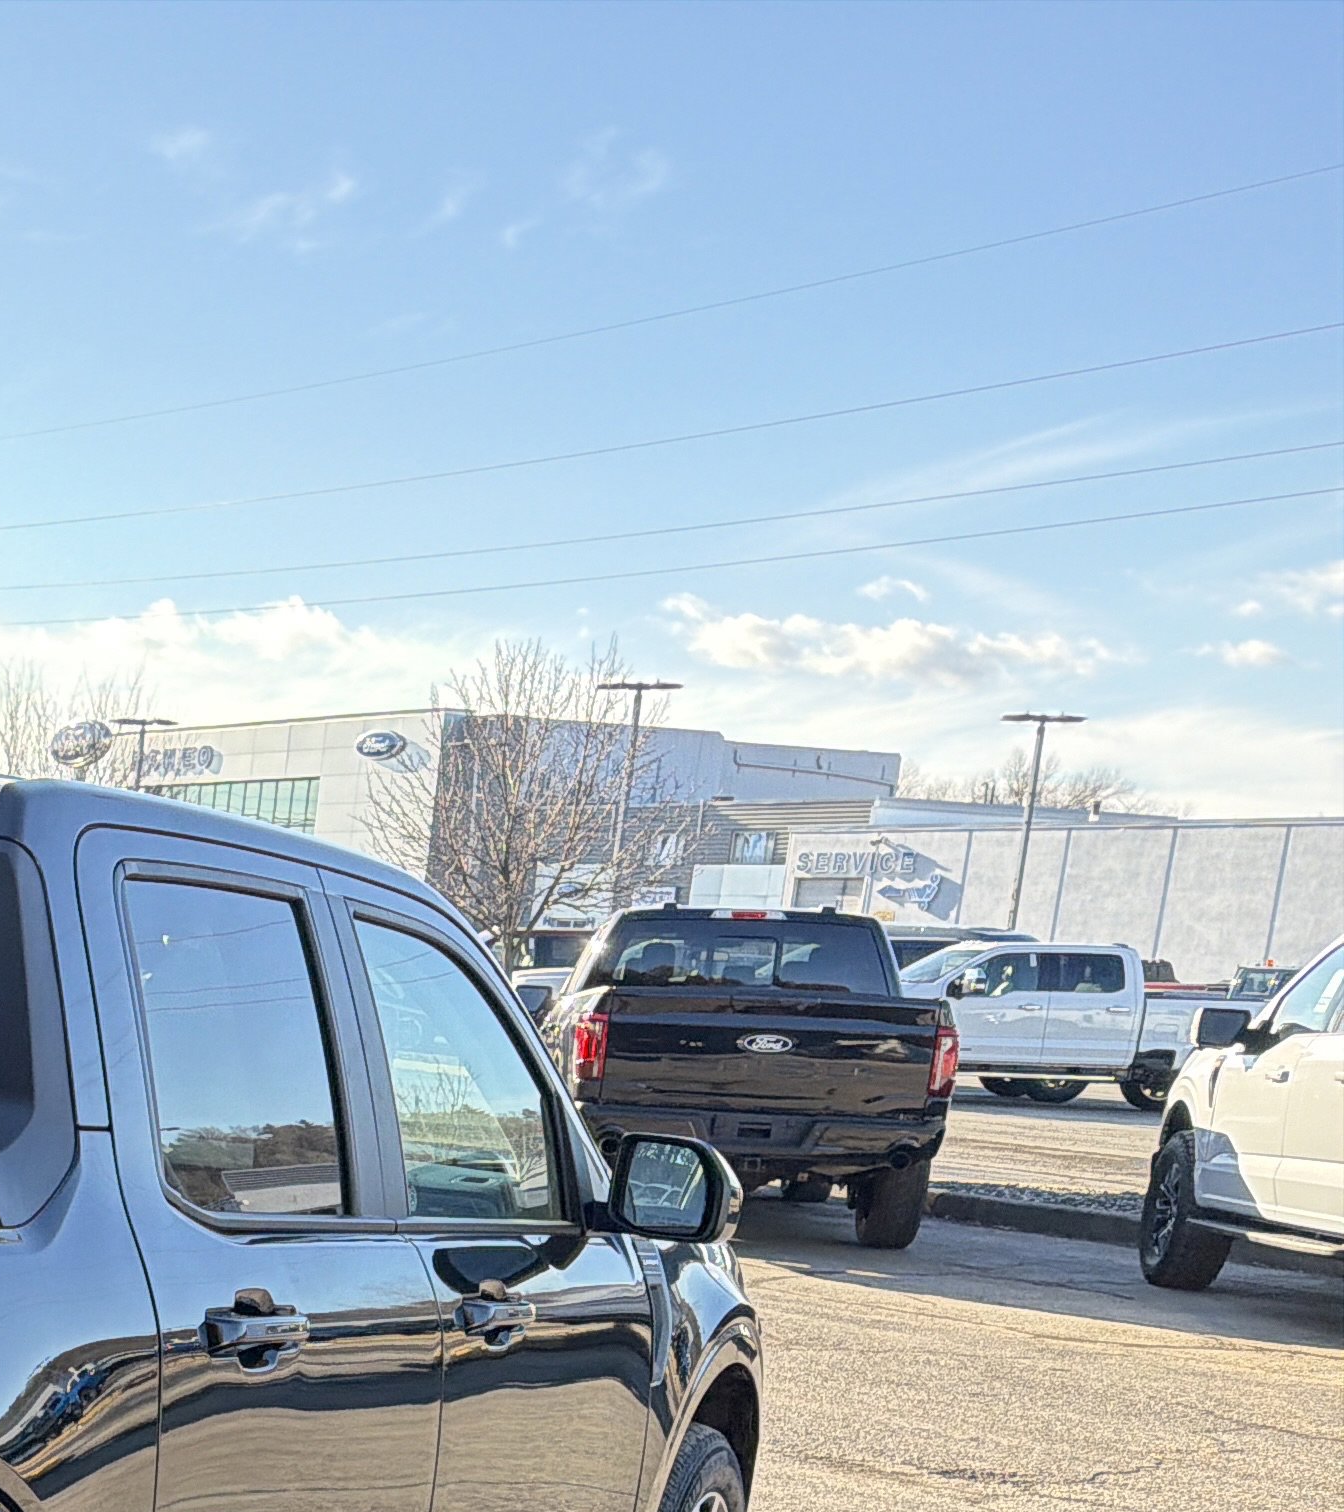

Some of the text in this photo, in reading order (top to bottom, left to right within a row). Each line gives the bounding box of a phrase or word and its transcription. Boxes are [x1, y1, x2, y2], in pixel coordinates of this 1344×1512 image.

[362, 736, 390, 753] Ford
[797, 852, 915, 873] SERVICE
[752, 1036, 784, 1050] Ford
